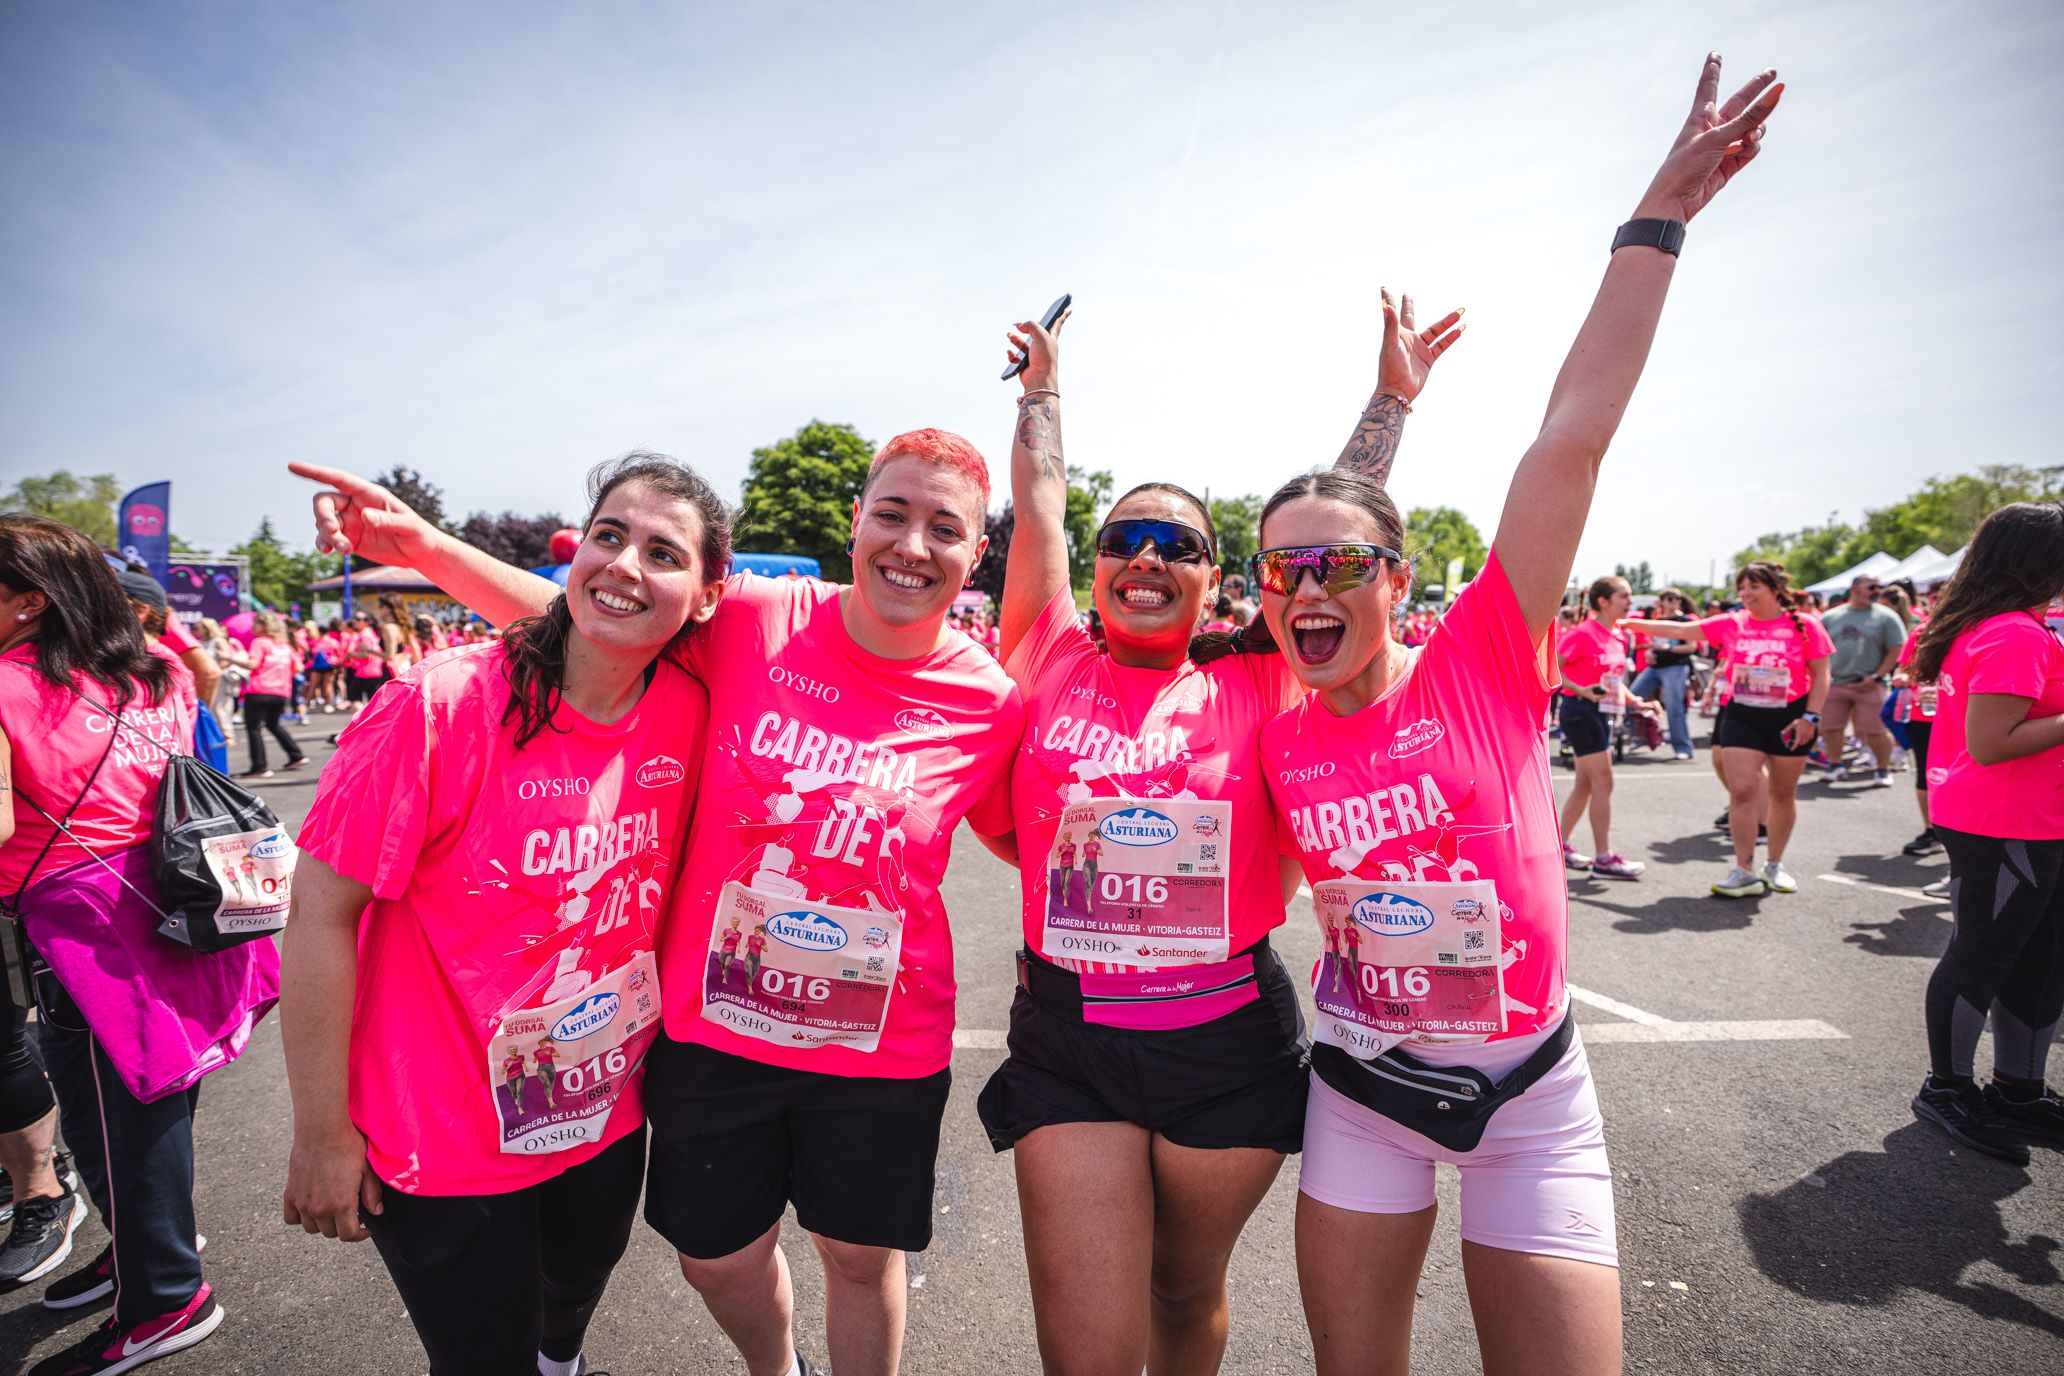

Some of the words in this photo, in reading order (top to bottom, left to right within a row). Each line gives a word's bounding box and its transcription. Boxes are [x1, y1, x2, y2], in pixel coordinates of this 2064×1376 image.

[768, 666, 840, 704] OYSHO
[114, 730, 143, 749] DE
[146, 724, 173, 743] LA
[897, 713, 950, 739] ASTURIANA
[114, 742, 180, 768] MUJER
[750, 711, 918, 799] CARRERA
[1043, 715, 1192, 775] CARRERA
[639, 770, 680, 783] ASTURIANA
[1279, 761, 1336, 786] OYSHO
[518, 777, 590, 800] OYSHO
[1064, 812, 1098, 826] SUMA
[1071, 807, 1097, 816] DORSAL
[1289, 773, 1455, 853] CARRERA
[810, 795, 887, 868] DE
[1105, 821, 1172, 839] ASTURIANA
[1117, 819, 1143, 827] CENTRAL
[219, 844, 248, 854] SUMA
[521, 807, 659, 876] CARRERA
[1100, 874, 1169, 904] 016
[1173, 879, 1222, 887] CORREDORA
[594, 871, 636, 937] DE
[735, 898, 765, 918] SUMA
[736, 891, 744, 899] TU
[743, 895, 766, 908] DORSAL
[1321, 894, 1349, 907] SUMA
[229, 917, 272, 928] OYSHO
[1127, 907, 1143, 920] 31
[1359, 905, 1428, 926] ASTURIANA
[772, 920, 841, 946] ASTURIANA
[785, 920, 812, 931] CENTRAL
[1050, 916, 1085, 929] CARRERA
[1086, 920, 1098, 930] DE
[1099, 922, 1110, 931] LA
[1111, 922, 1141, 933] MUJER
[1147, 926, 1222, 937] VITORIA-GASTEIZ
[1062, 936, 1116, 954] OYSHO
[1152, 947, 1208, 959] Santander
[1361, 965, 1431, 997] 016
[1435, 969, 1494, 978] CORREDORA
[761, 969, 831, 1001] 016
[836, 982, 885, 993] CORREDORA
[1140, 984, 1167, 993] Carrera
[1176, 980, 1194, 993] Mujer
[709, 992, 745, 1006] CARRERA
[747, 1000, 758, 1010] DE
[758, 1003, 769, 1015] LA
[770, 1007, 798, 1022] MUJER
[804, 1016, 877, 1031] VITORIA-GASTEIZ
[781, 1000, 806, 1013] 694
[1318, 1001, 1356, 1020] CARRERA
[1358, 1011, 1368, 1023] DE
[1367, 1015, 1377, 1025] LA
[1376, 1018, 1405, 1032] MUJER
[1412, 1020, 1499, 1032] VITORIA-GASTEIZ
[1384, 1003, 1410, 1017] 300
[505, 1022, 547, 1038] SUMA
[514, 1016, 545, 1026] DORSAL
[558, 1002, 618, 1038] ASTURIANA
[720, 1008, 772, 1034] OYSHO
[806, 1033, 859, 1044] Santander
[1333, 1023, 1382, 1052] OYSHO
[562, 1047, 626, 1093] 016
[587, 1083, 612, 1101] 696
[507, 1114, 549, 1138] CARRERA
[551, 1111, 564, 1122] DE
[565, 1110, 578, 1120] LA
[579, 1100, 609, 1117] MUJER
[524, 1126, 586, 1152] OYSHO
